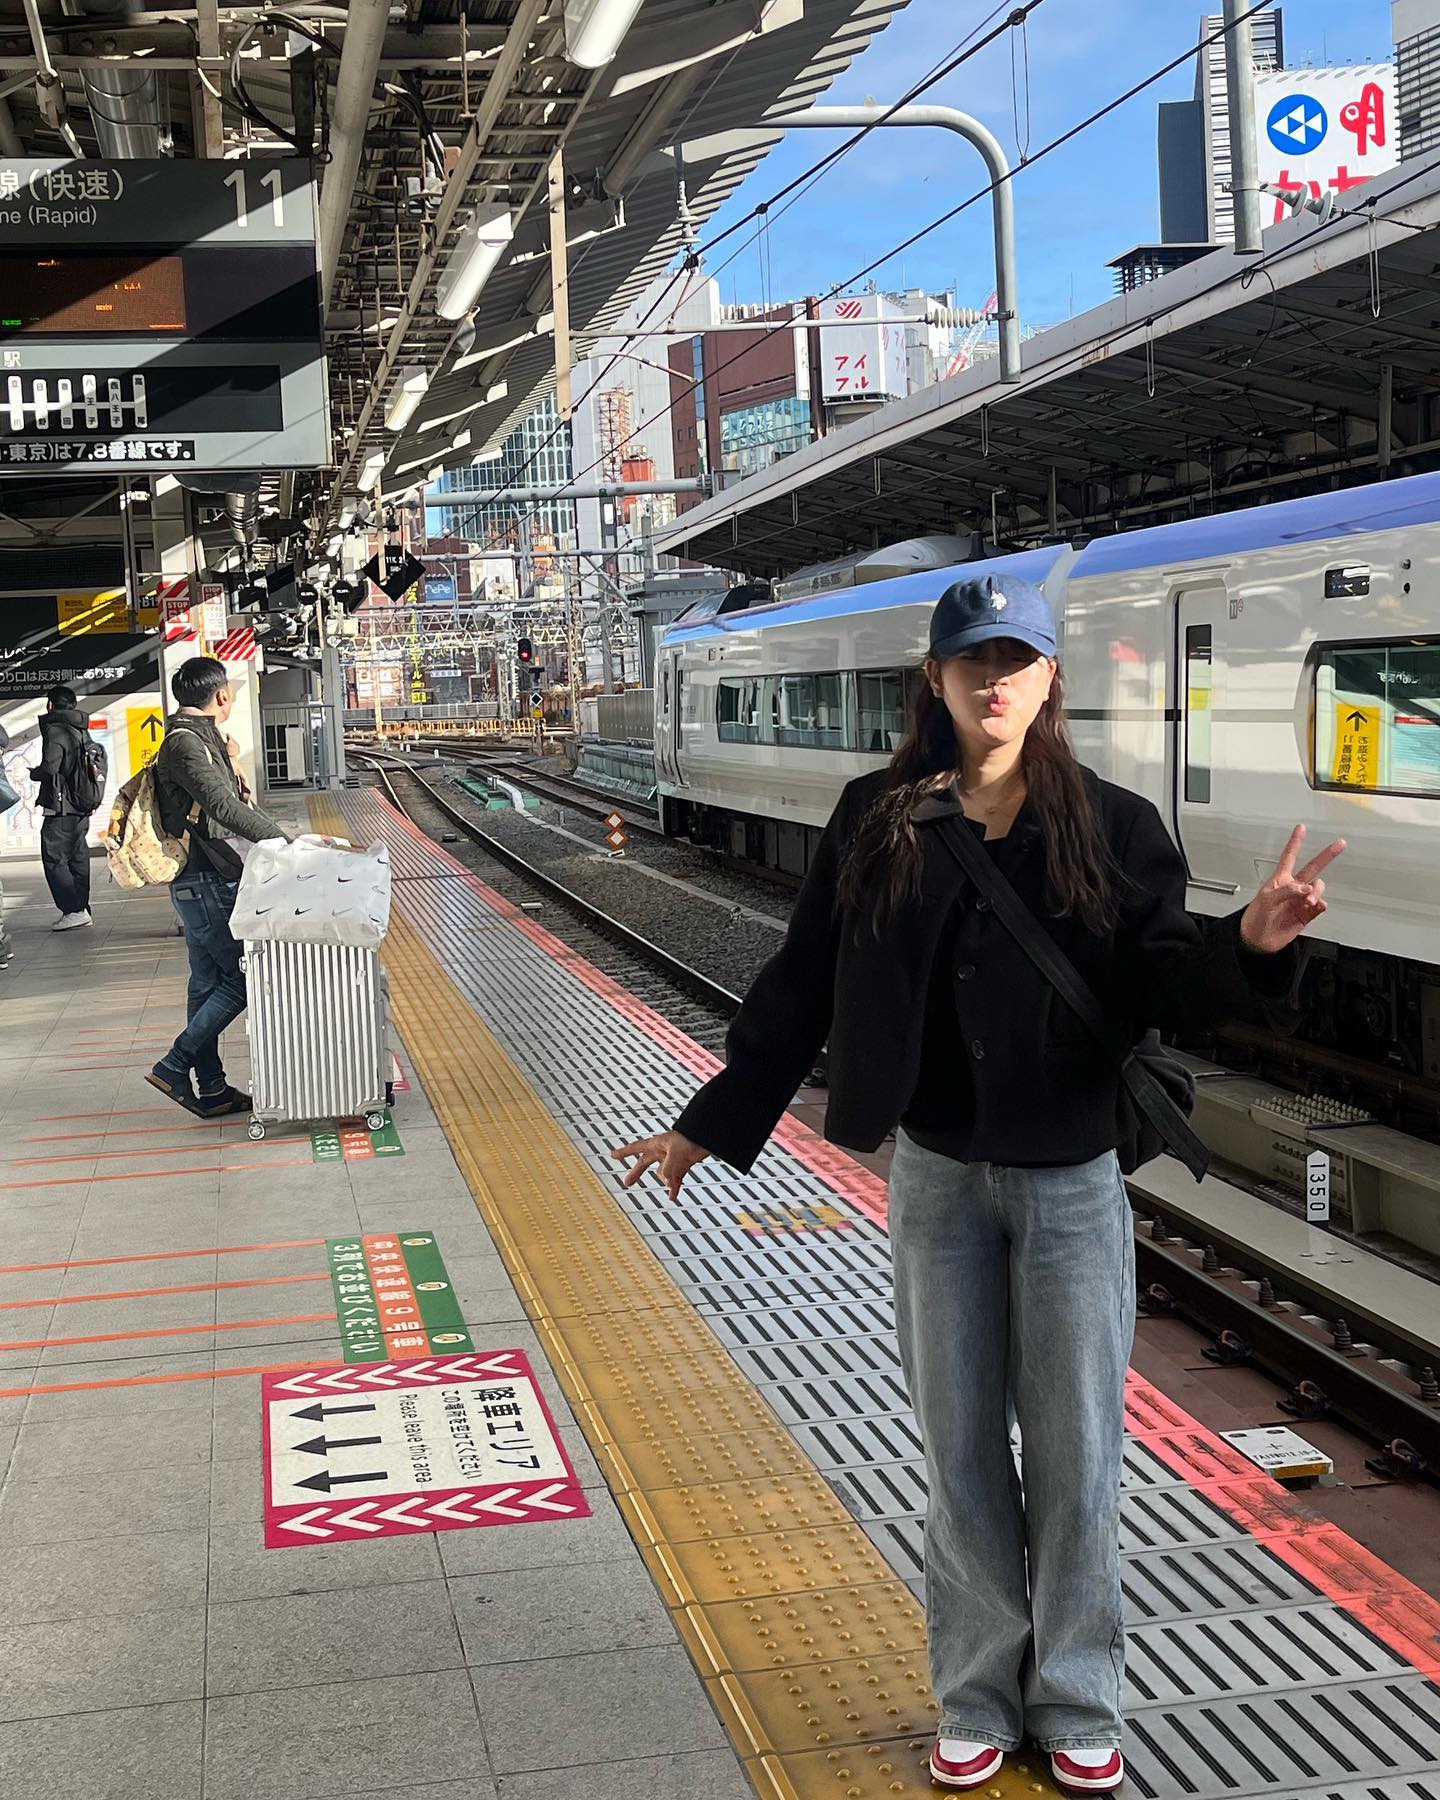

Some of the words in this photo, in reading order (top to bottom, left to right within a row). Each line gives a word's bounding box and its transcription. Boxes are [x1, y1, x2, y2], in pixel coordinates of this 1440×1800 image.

[223, 169, 284, 228] 11
[29, 206, 97, 228] (Rapid)
[4, 351, 21, 368] 駅
[835, 354, 867, 371] アイ
[835, 376, 869, 391] フル
[85, 379, 96, 425] 八王子
[0, 440, 192, 461] ・東京)は7,8番線です。
[1310, 1163, 1326, 1211] 1350
[333, 1244, 380, 1353] 3列でお並びください
[367, 1240, 425, 1348] 中央快速線9号車
[399, 1394, 419, 1419] Please
[404, 1420, 425, 1443] leave
[441, 1389, 483, 1479] この場所を空けてください
[471, 1386, 541, 1469] 降車エリア
[409, 1444, 433, 1461] this
[413, 1463, 433, 1483] area
